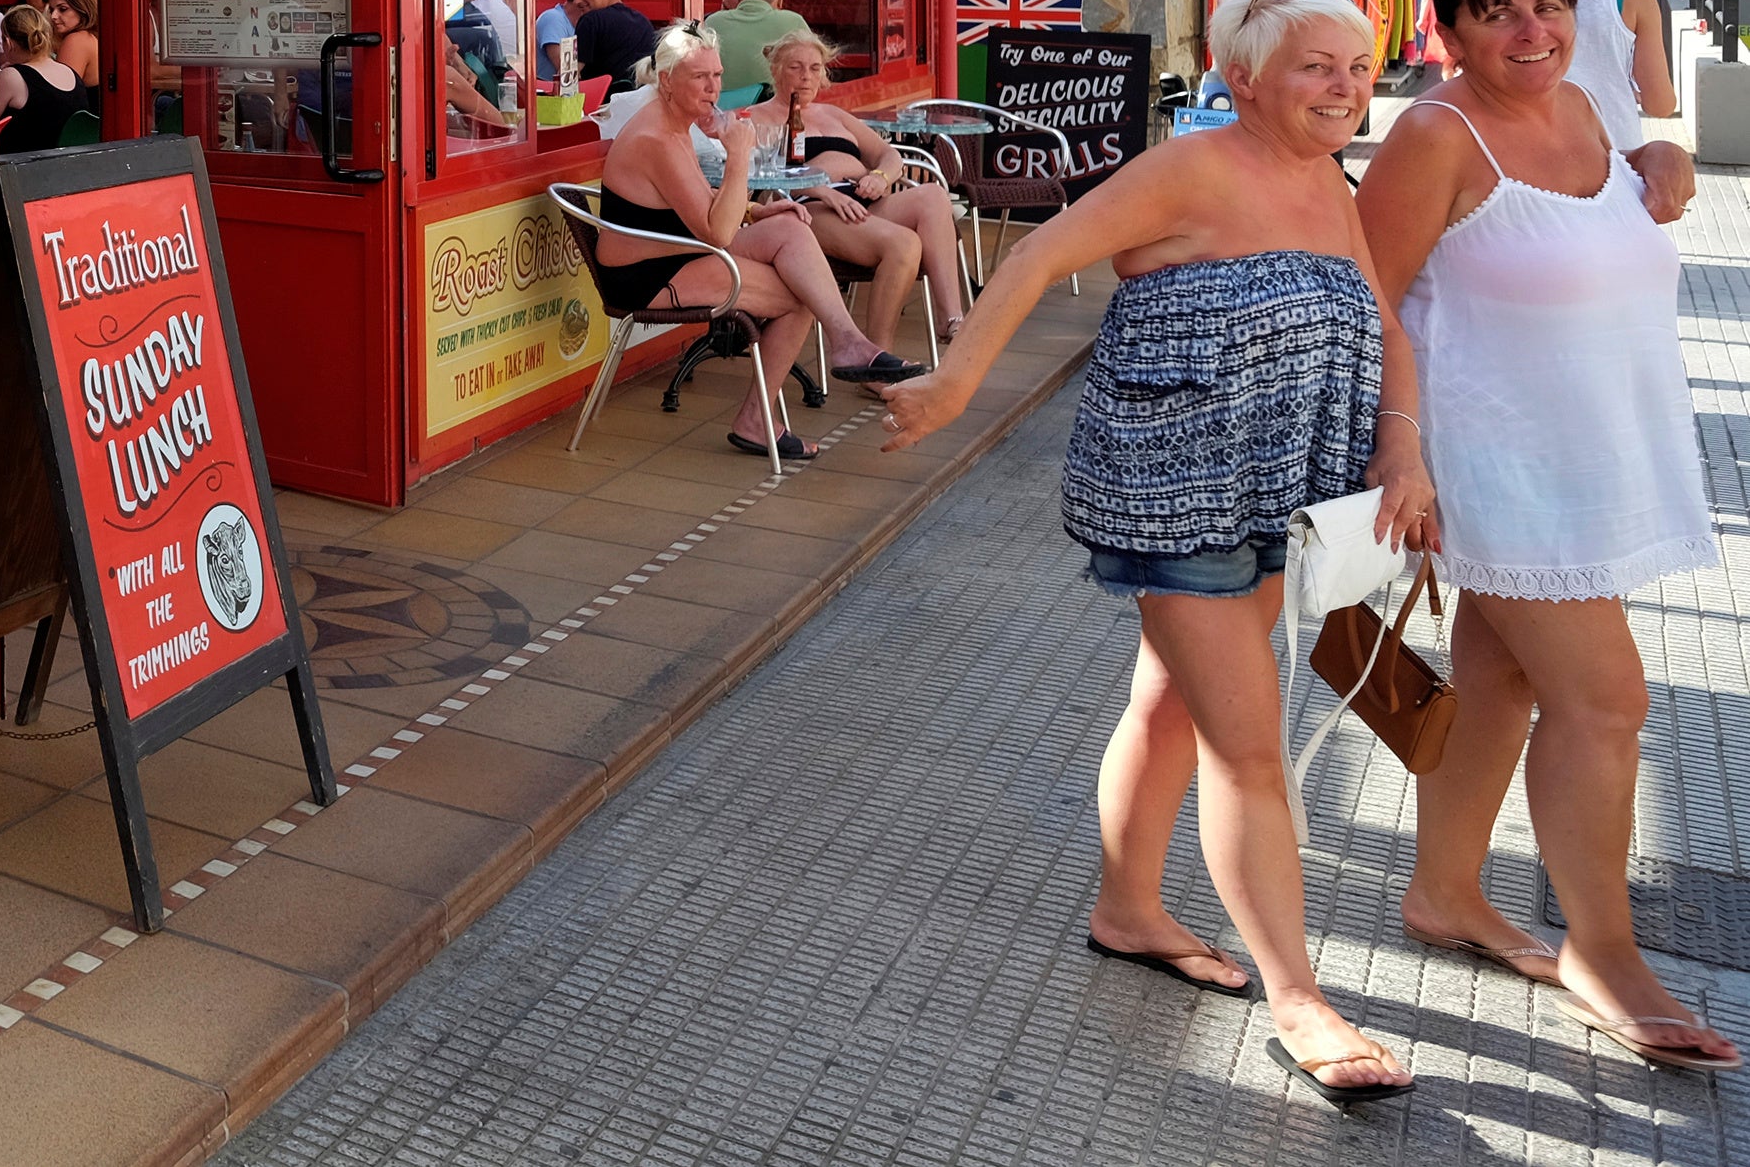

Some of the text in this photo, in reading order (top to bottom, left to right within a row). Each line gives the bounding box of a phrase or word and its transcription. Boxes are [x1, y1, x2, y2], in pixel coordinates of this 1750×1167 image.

[1000, 43, 1132, 67] Try One of Our
[997, 100, 1125, 134] SPECIALITY
[999, 74, 1125, 108] DELICIOUS
[994, 132, 1124, 179] GRILLS
[43, 205, 199, 306] Traditional
[433, 215, 585, 315] Roast Chicke
[436, 332, 458, 357] SERVED
[459, 326, 476, 348] WITH
[476, 319, 499, 342] THICKLY
[499, 315, 511, 333] CUT
[511, 312, 527, 330] CHIPS
[83, 310, 204, 435] SUNDAY
[454, 375, 466, 401] TO
[469, 368, 484, 396] EAT
[486, 362, 495, 390] IN
[504, 350, 522, 382] TAKE
[523, 341, 545, 371] AWAY
[106, 384, 212, 515] LUNCH
[116, 541, 186, 597] WITH ALL
[146, 597, 175, 630] THE
[128, 634, 210, 690] TRIMMINGS
